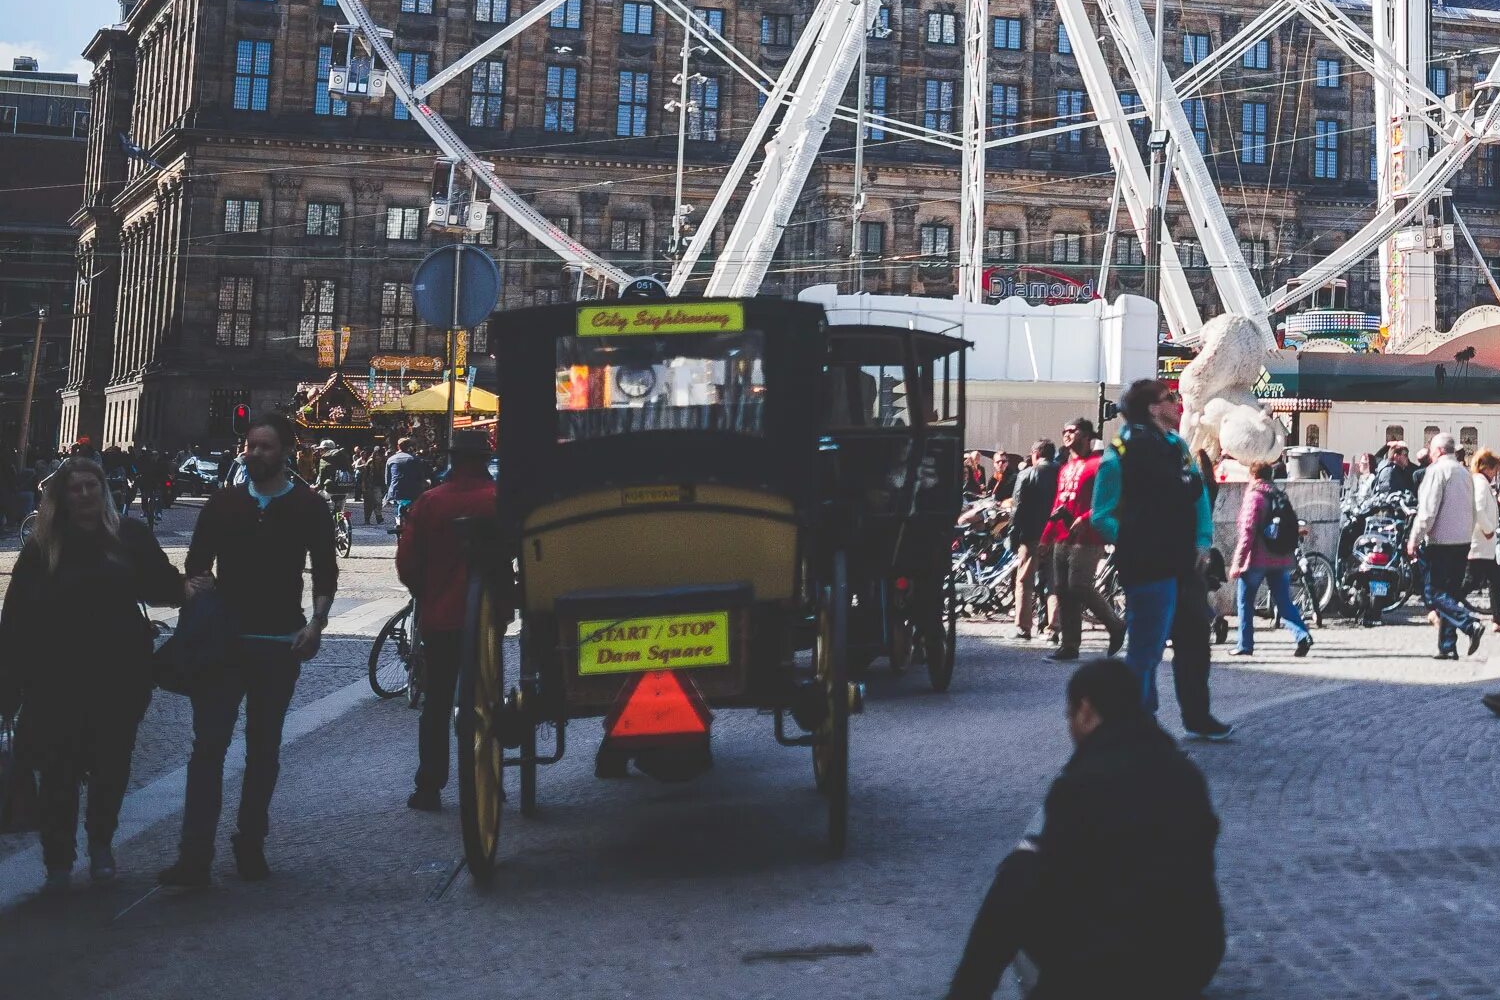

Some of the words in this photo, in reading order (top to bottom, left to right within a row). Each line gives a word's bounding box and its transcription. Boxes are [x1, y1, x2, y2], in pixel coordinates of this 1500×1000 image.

[989, 277, 1094, 299] Diamond
[591, 311, 628, 331] City
[592, 625, 649, 643] START
[667, 620, 717, 638] STOP
[596, 648, 641, 664] Dam
[647, 644, 714, 663] Square
